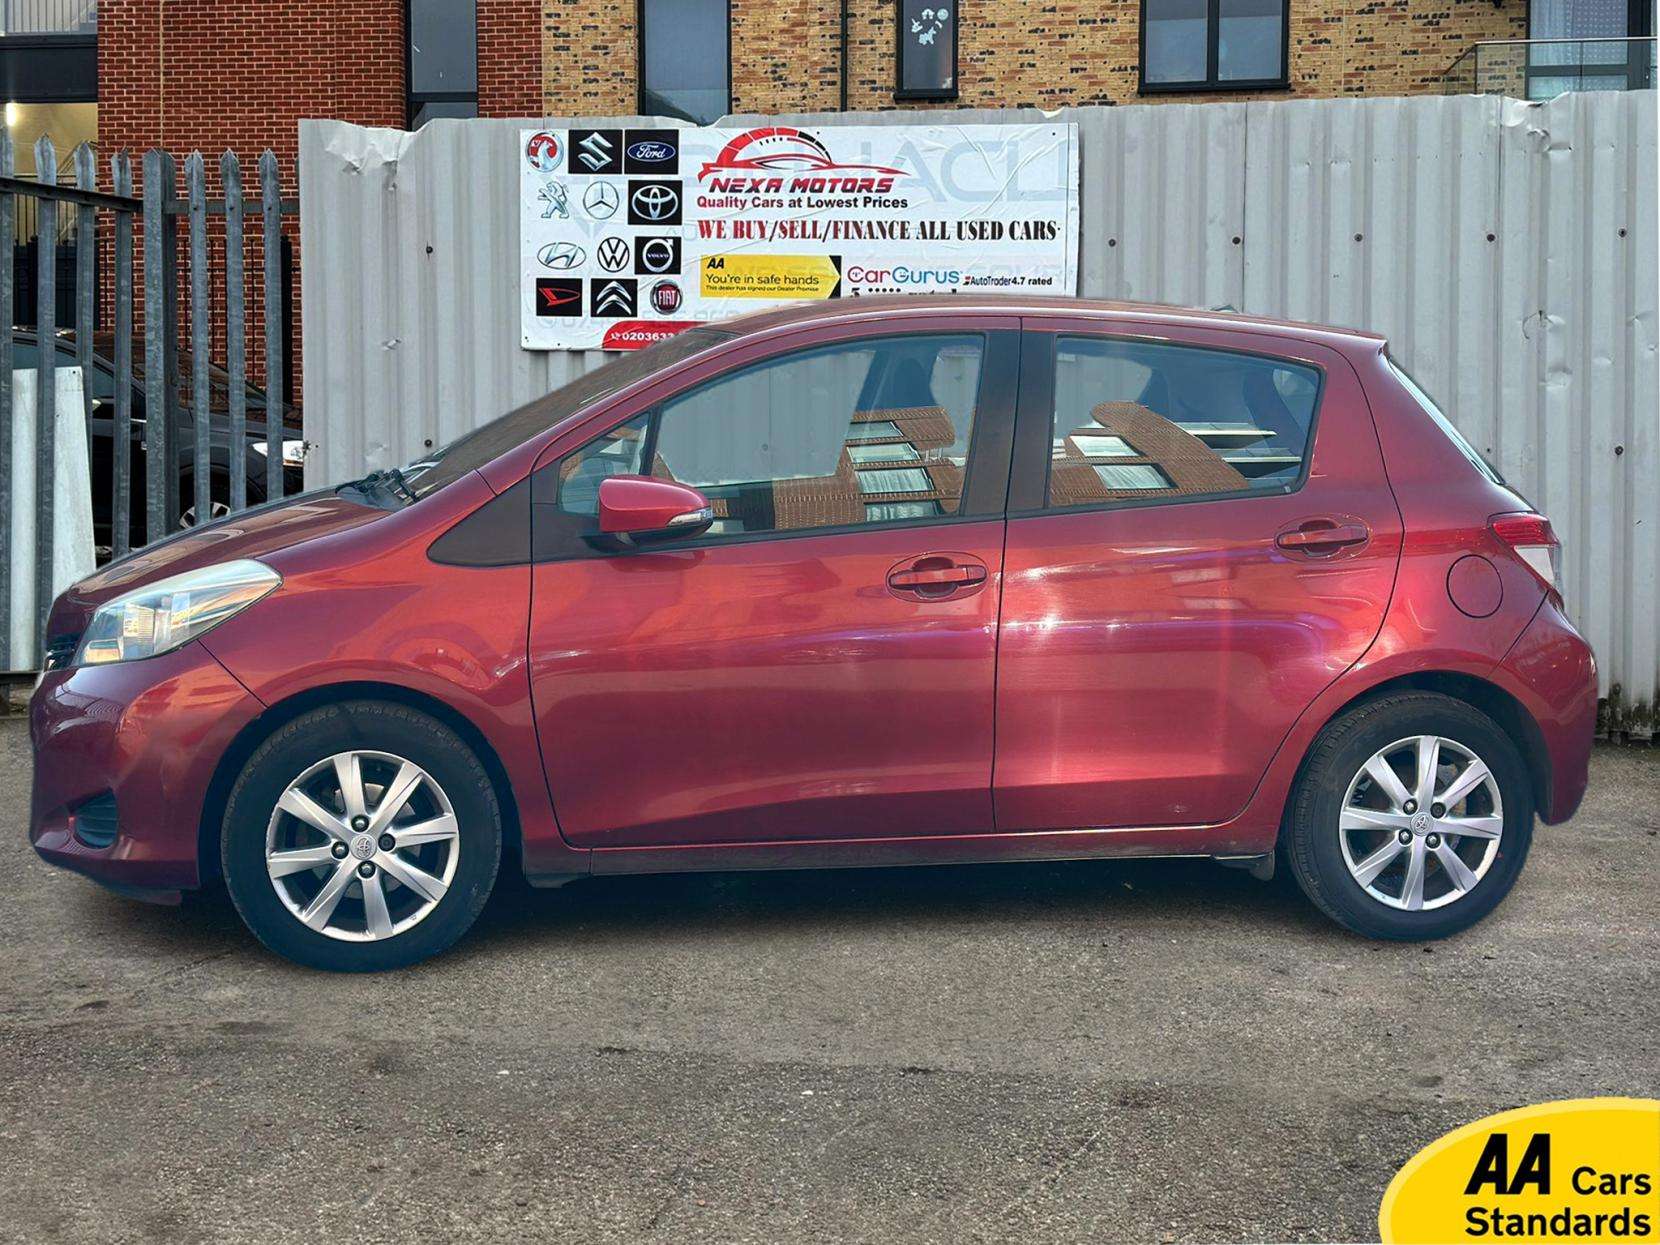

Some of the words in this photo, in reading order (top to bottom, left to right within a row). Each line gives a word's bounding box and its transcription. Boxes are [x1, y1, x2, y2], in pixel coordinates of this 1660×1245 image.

[637, 145, 666, 159] Ford
[709, 178, 783, 193] NEXA
[789, 178, 894, 193] MOTORS
[697, 196, 747, 210] Quality
[752, 196, 784, 208] Cars
[789, 197, 803, 208] at
[807, 196, 859, 208] Lowest
[863, 196, 908, 208] Prices
[697, 219, 727, 240] WE
[733, 220, 911, 243] BUY/SELL/FINANCE
[916, 220, 950, 240] ALL
[956, 220, 1004, 241] USED
[1008, 220, 1057, 241] CARS
[706, 258, 724, 269] AA
[706, 274, 741, 284] You're
[744, 274, 754, 284] in
[757, 274, 781, 284] safe
[784, 274, 819, 285] hands
[847, 266, 960, 284] CarGurus
[971, 276, 1011, 286] AutoTrader
[1011, 276, 1026, 286] 4.7
[1028, 277, 1053, 286] rated
[658, 290, 676, 306] FIAT
